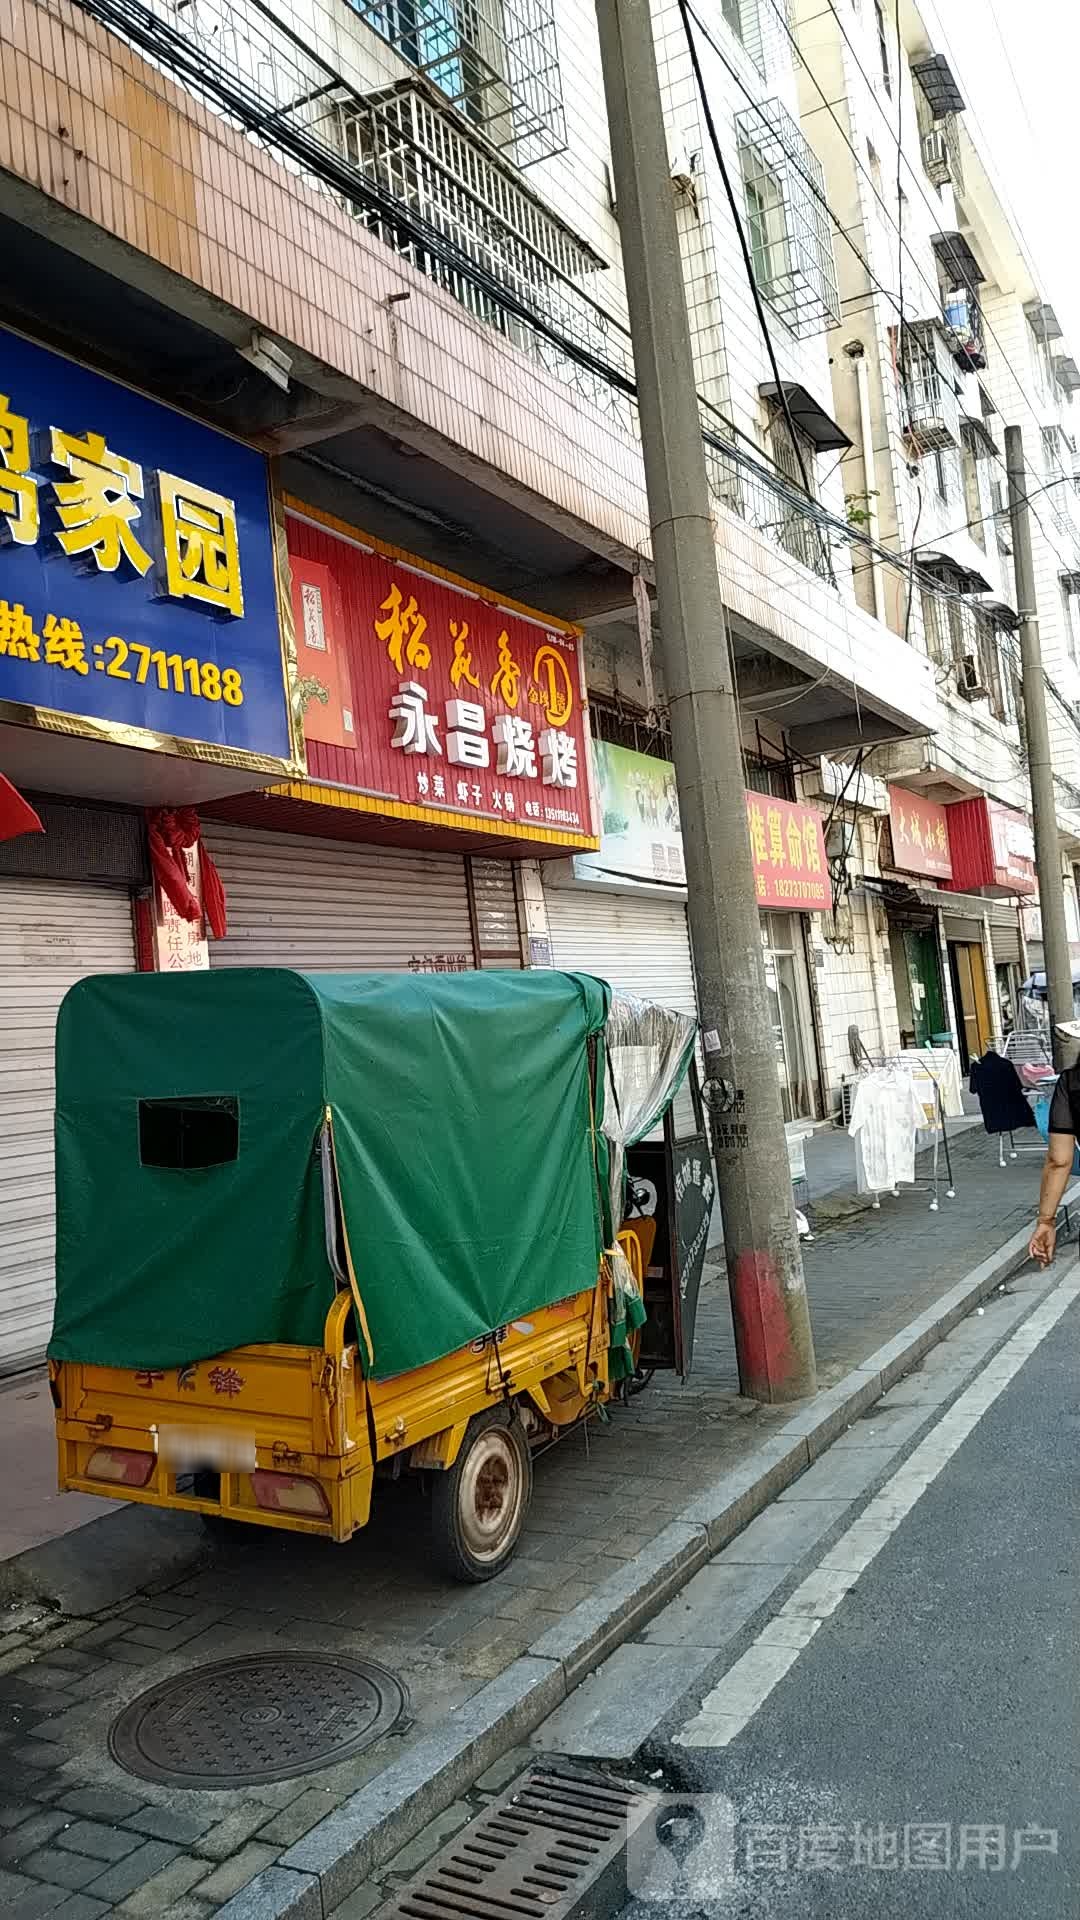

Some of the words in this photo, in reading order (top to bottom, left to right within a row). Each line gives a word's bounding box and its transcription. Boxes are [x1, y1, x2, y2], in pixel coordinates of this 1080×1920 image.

[389, 681, 578, 789] 永昌烧烤
[416, 771, 446, 799] 炒菜
[456, 779, 483, 806] 虾子
[492, 788, 515, 814] 火锅
